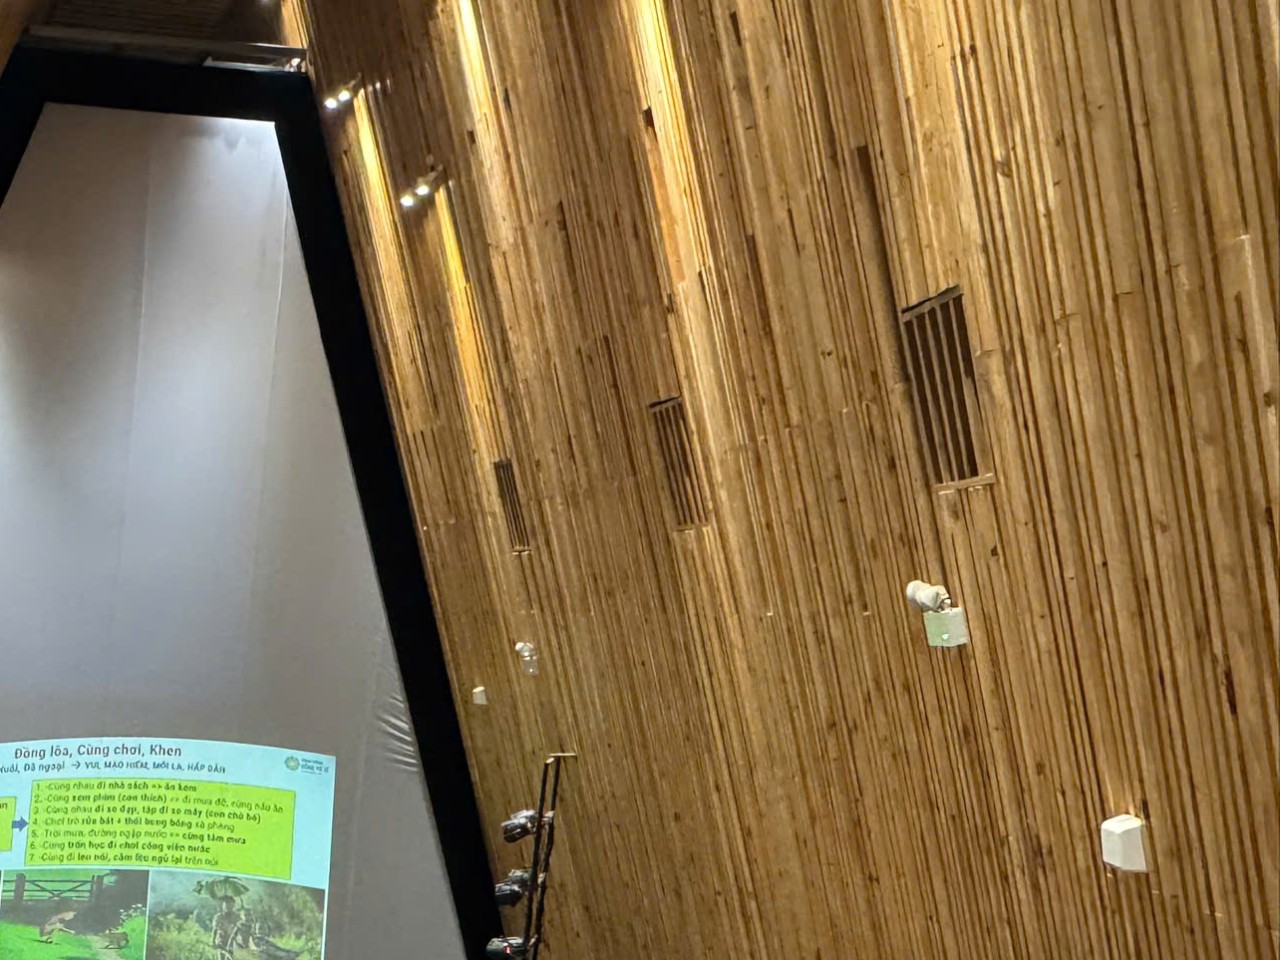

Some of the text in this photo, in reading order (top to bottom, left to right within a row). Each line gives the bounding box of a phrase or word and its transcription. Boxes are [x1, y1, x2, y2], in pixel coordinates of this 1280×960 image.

[77, 743, 110, 757] Cùng
[114, 743, 144, 757] chơi,
[150, 743, 181, 757] Khen
